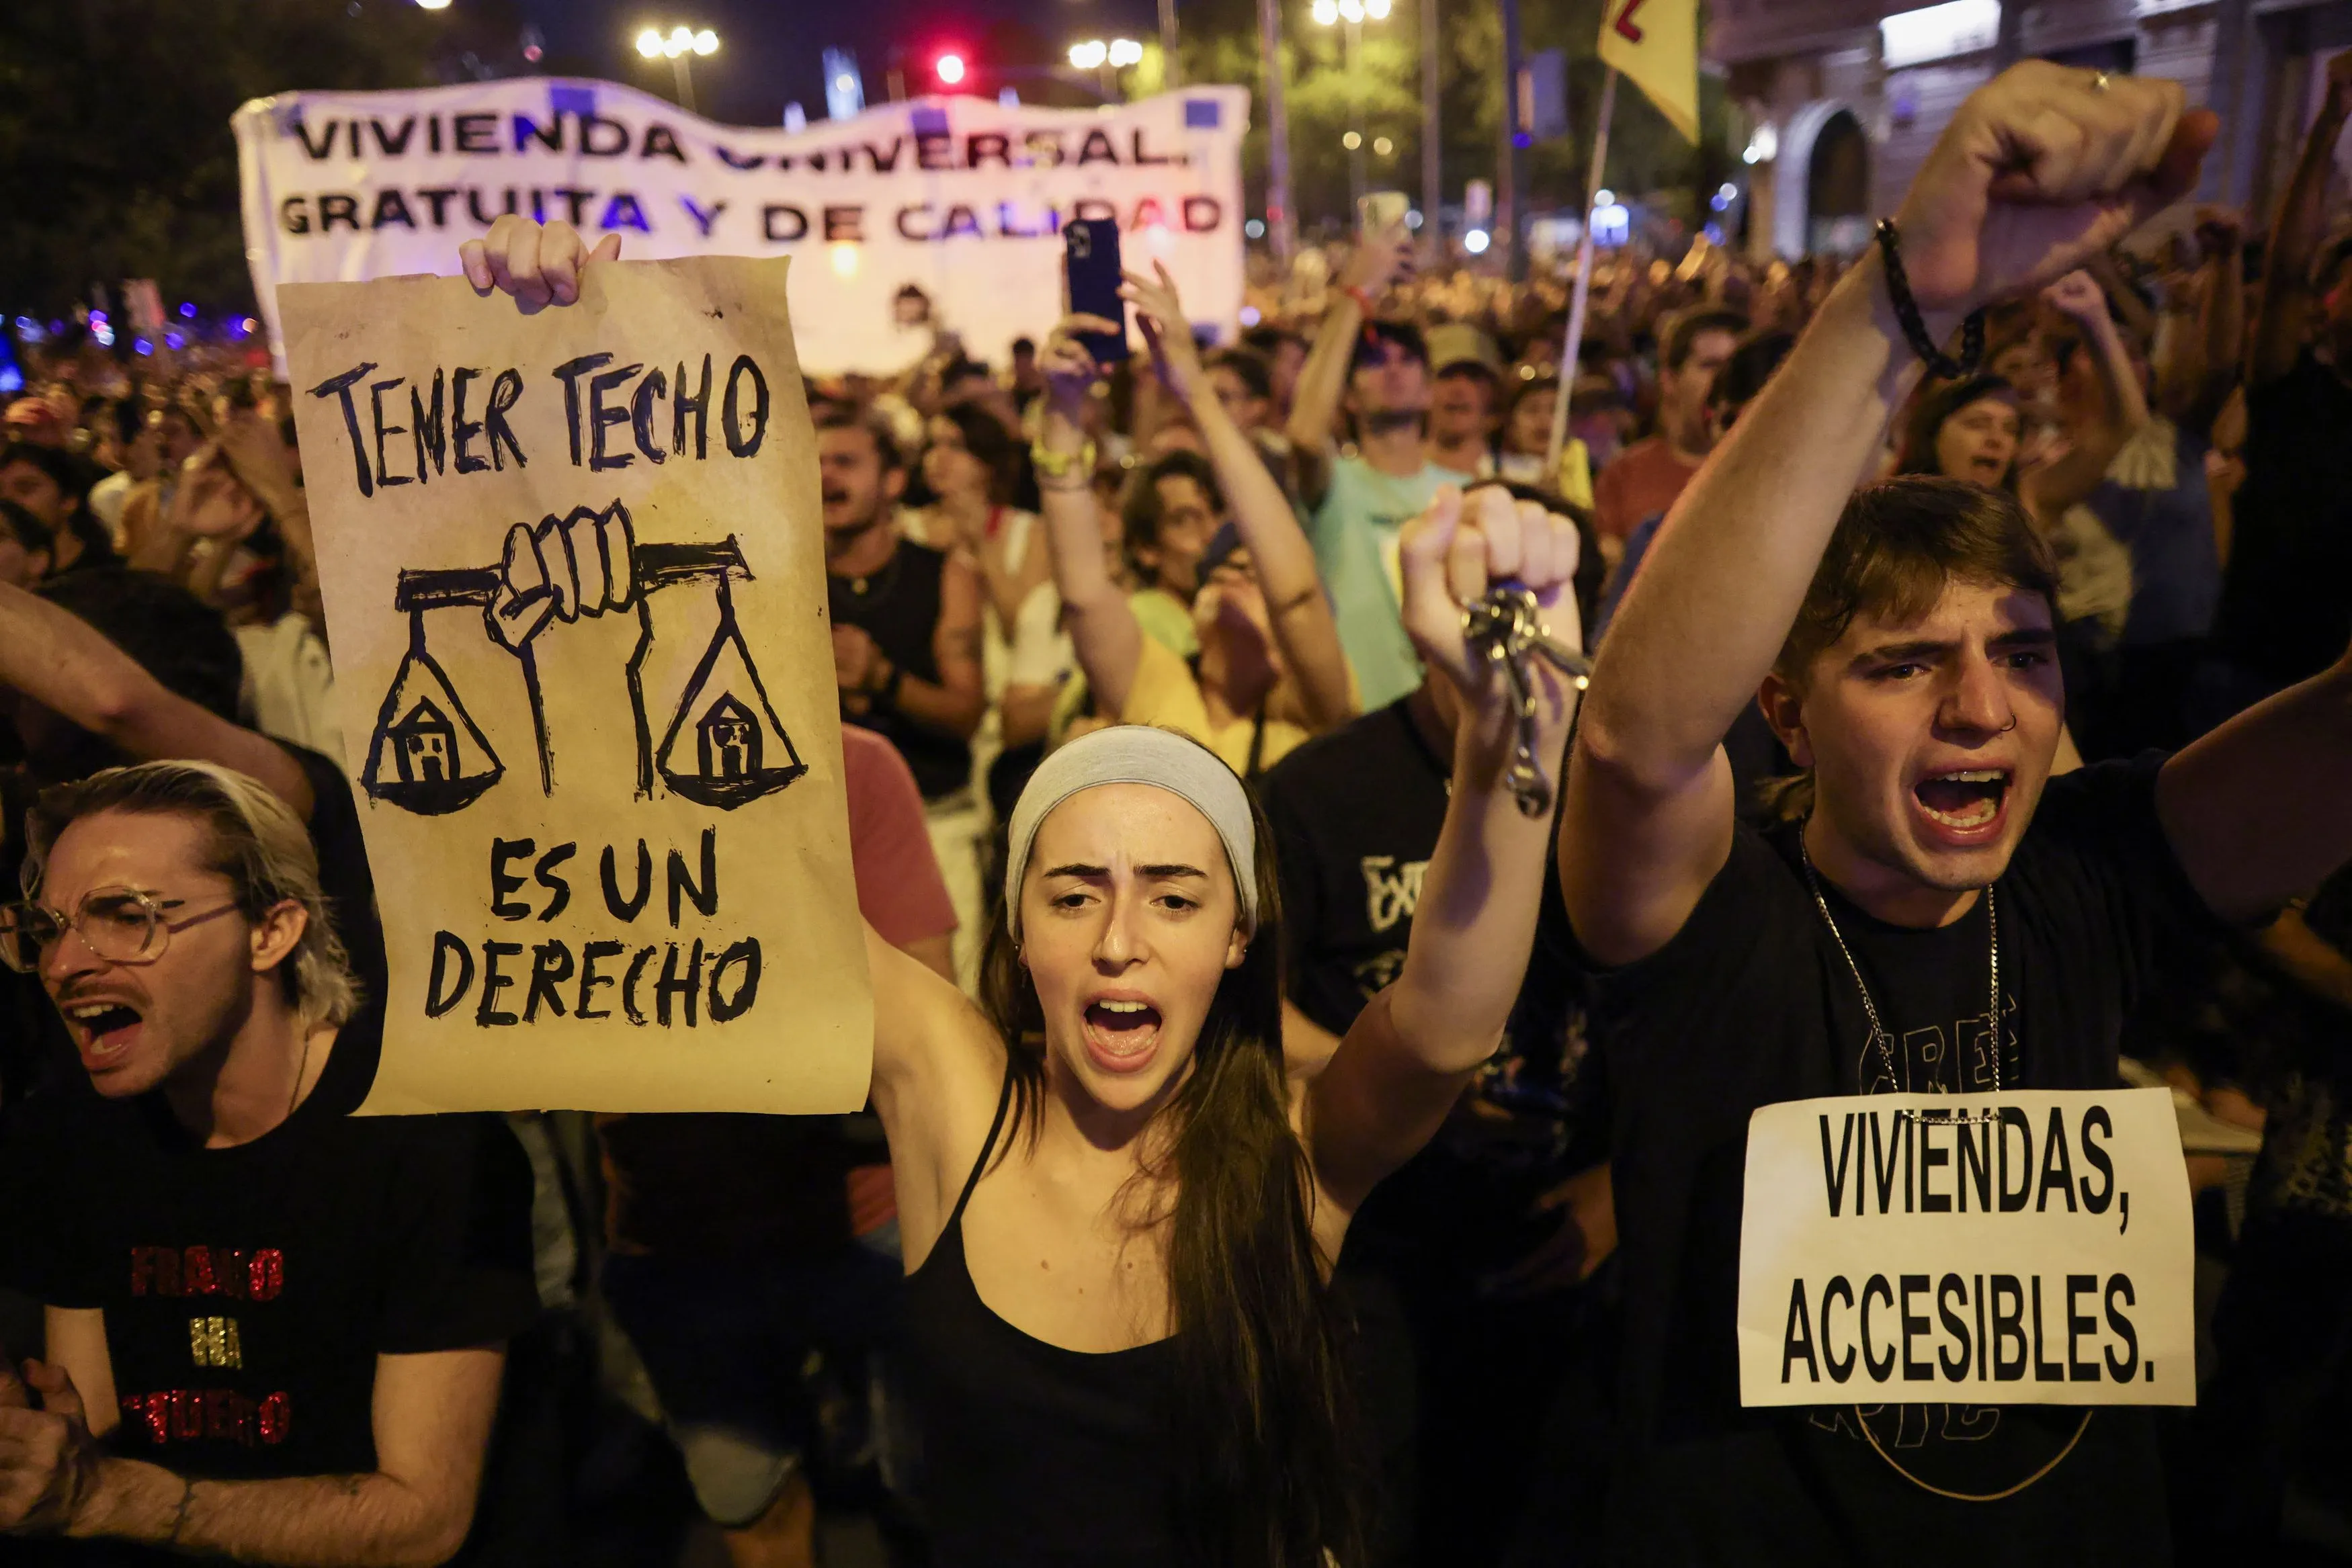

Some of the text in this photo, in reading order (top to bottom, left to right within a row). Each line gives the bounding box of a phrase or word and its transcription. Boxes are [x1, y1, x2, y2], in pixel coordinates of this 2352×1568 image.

[292, 110, 687, 163] VIVIENDA
[280, 187, 650, 233] GRATUITA
[684, 195, 726, 236] Y
[762, 204, 866, 243] DE
[304, 351, 770, 498] TENER TECHO
[490, 824, 718, 929] ES UN
[425, 930, 763, 1029] DERECHO
[1819, 1105, 2130, 1235] VIVIENDAS,
[1781, 1272, 2155, 1384] ACCESIBLES.
